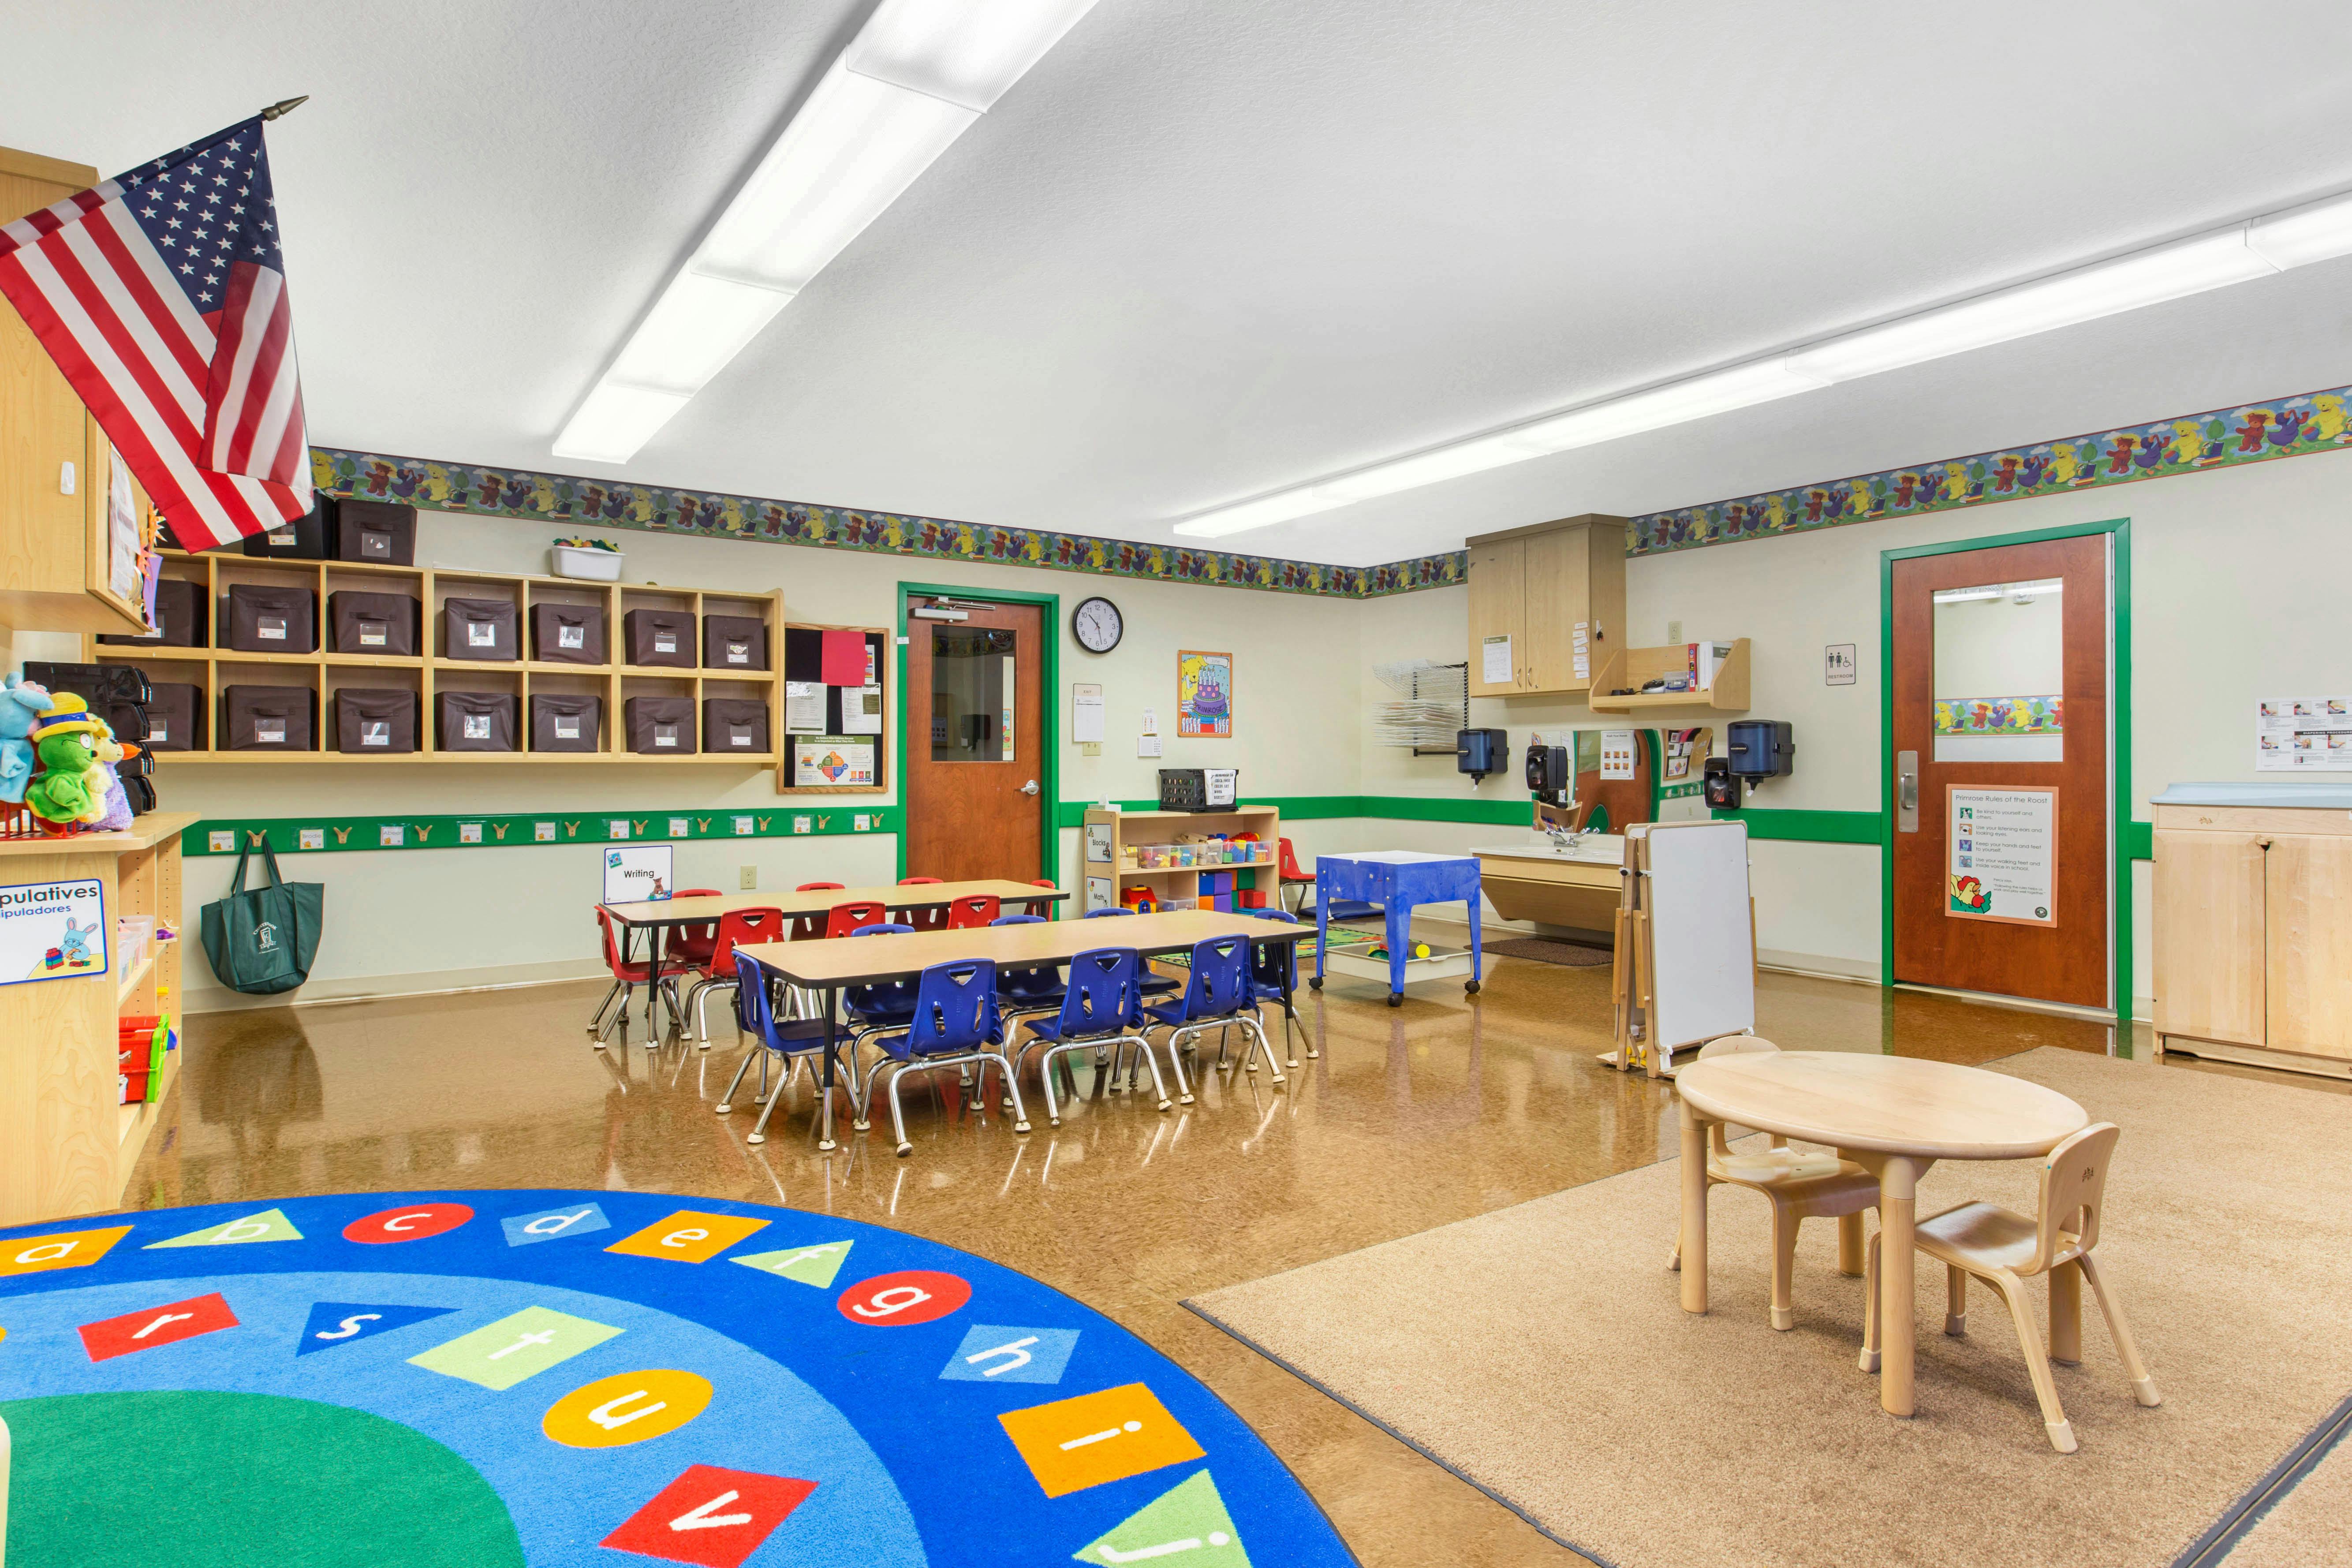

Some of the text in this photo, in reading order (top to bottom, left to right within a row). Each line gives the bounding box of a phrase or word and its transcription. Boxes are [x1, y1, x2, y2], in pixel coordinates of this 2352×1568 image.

[624, 870, 654, 878] Writing
[1094, 892, 1105, 901] Math
[0, 905, 71, 919] ipuladores
[211, 1217, 270, 1241] b
[384, 1213, 432, 1231] c
[525, 1211, 590, 1233] d
[661, 1228, 707, 1247] e
[15, 1241, 78, 1263] a
[773, 1246, 838, 1270] f
[854, 1286, 931, 1317] g
[133, 1313, 193, 1338] r
[316, 1314, 381, 1340] s
[488, 1329, 556, 1359] t
[966, 1336, 1038, 1377] h
[589, 1390, 666, 1430] u
[1060, 1420, 1142, 1450] i
[670, 1490, 751, 1530] v
[1097, 1531, 1230, 1563] j
